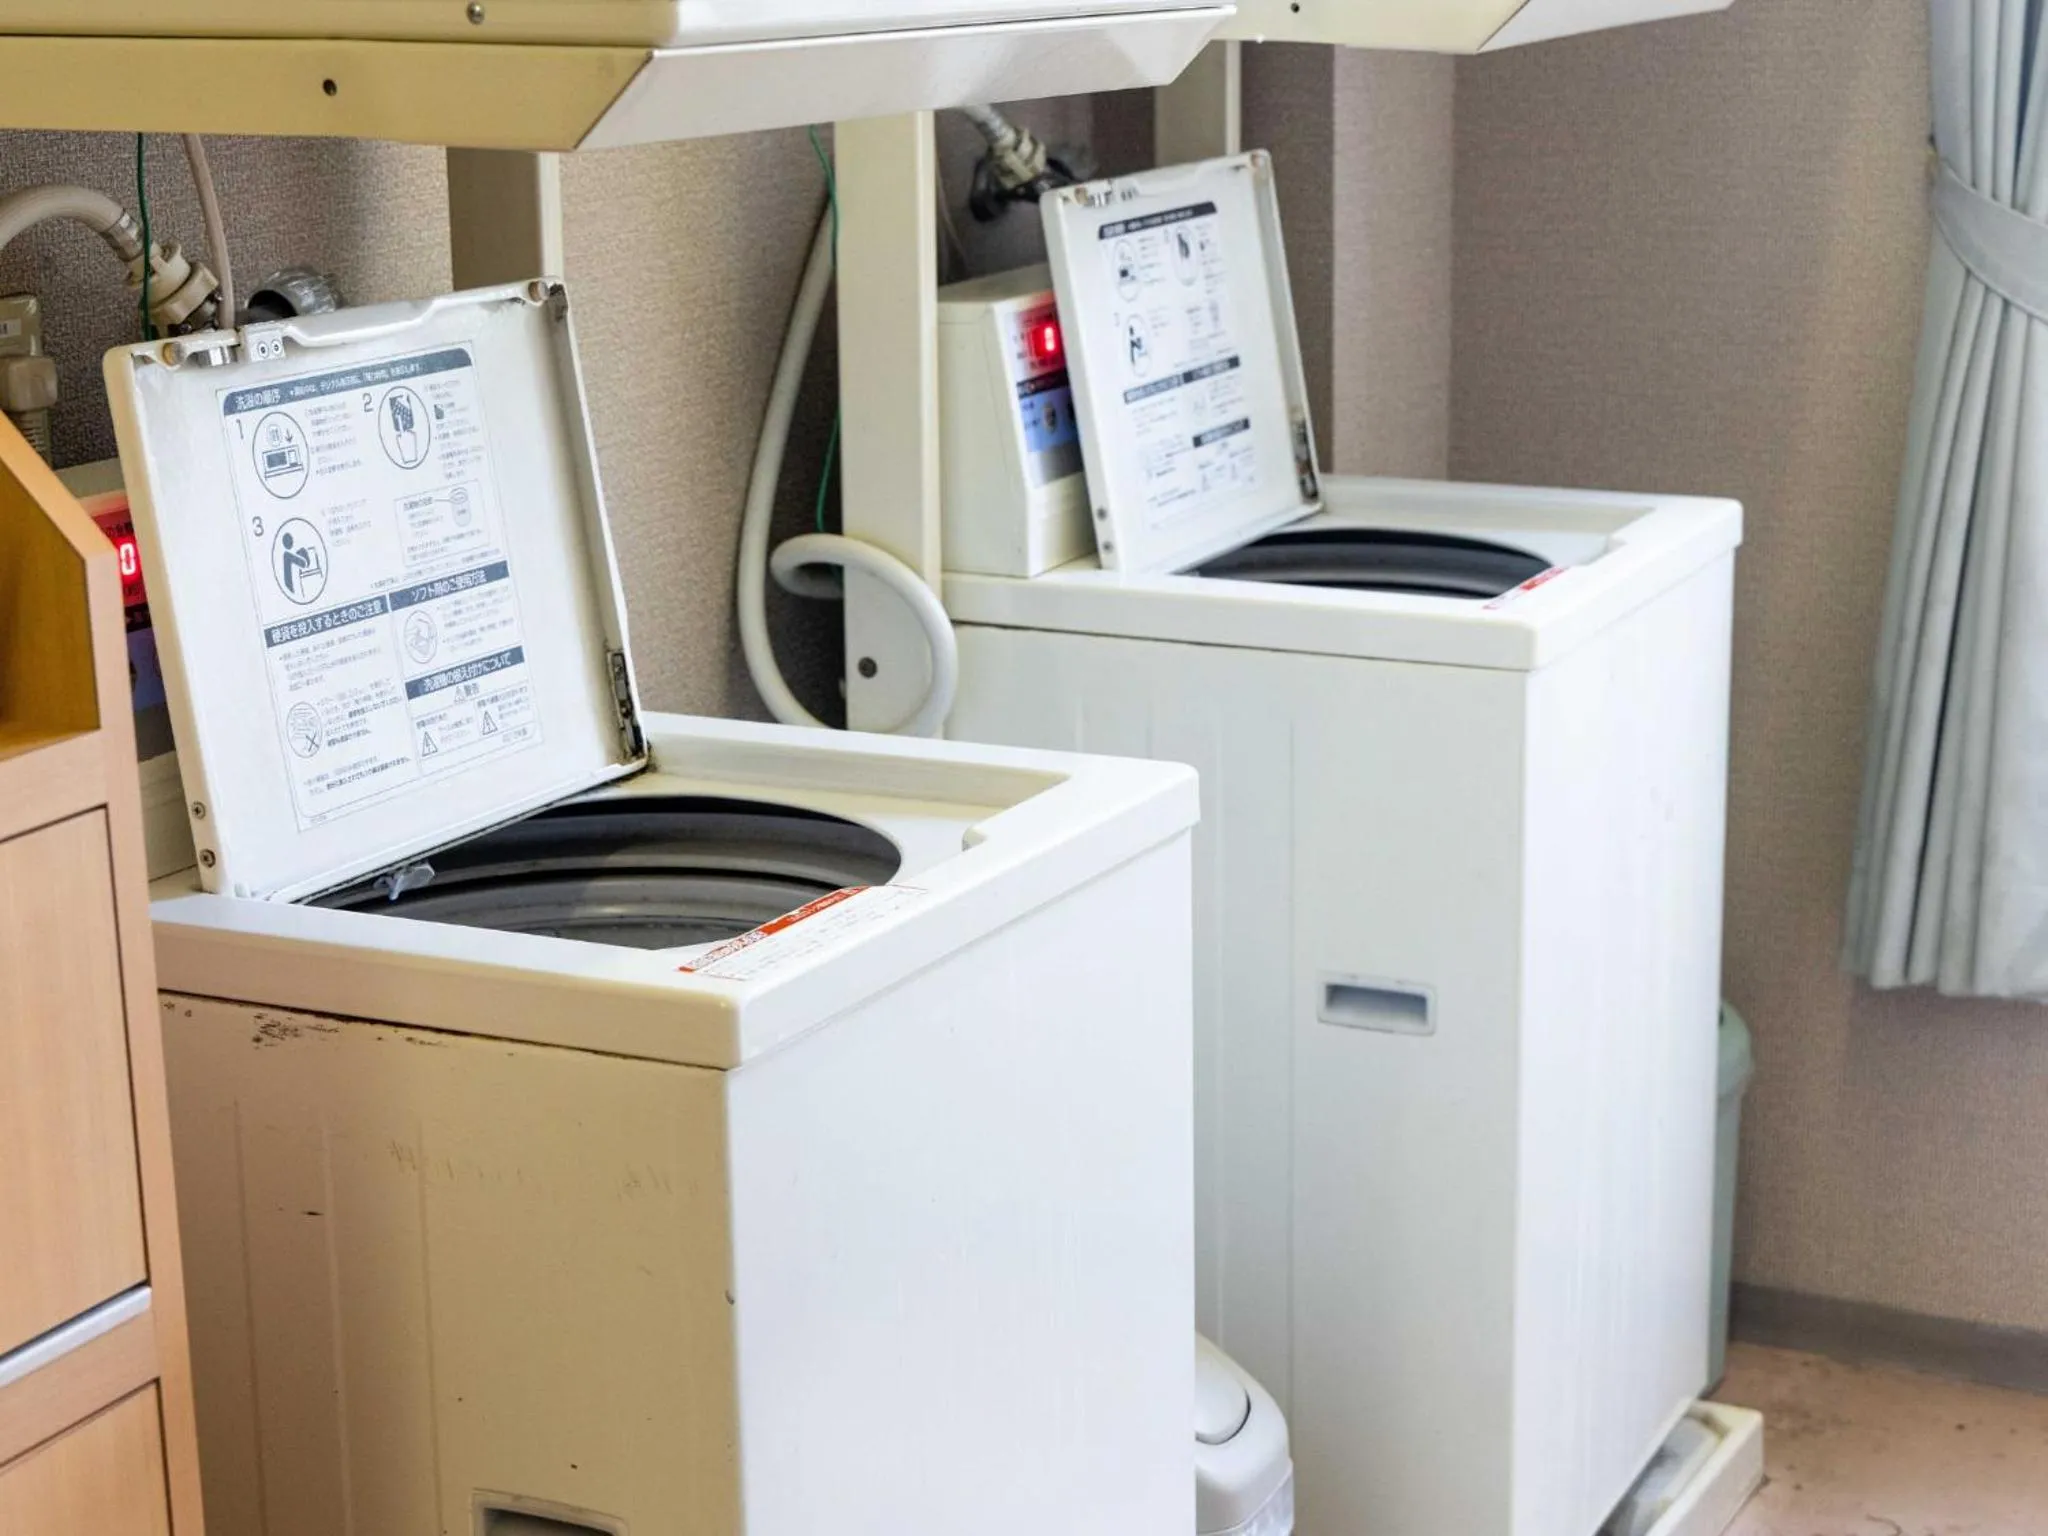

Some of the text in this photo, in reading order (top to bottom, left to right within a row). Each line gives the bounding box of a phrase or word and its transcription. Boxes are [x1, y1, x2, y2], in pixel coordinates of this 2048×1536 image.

[362, 393, 373, 413] 2
[235, 419, 244, 440] 1
[252, 516, 264, 537] 3
